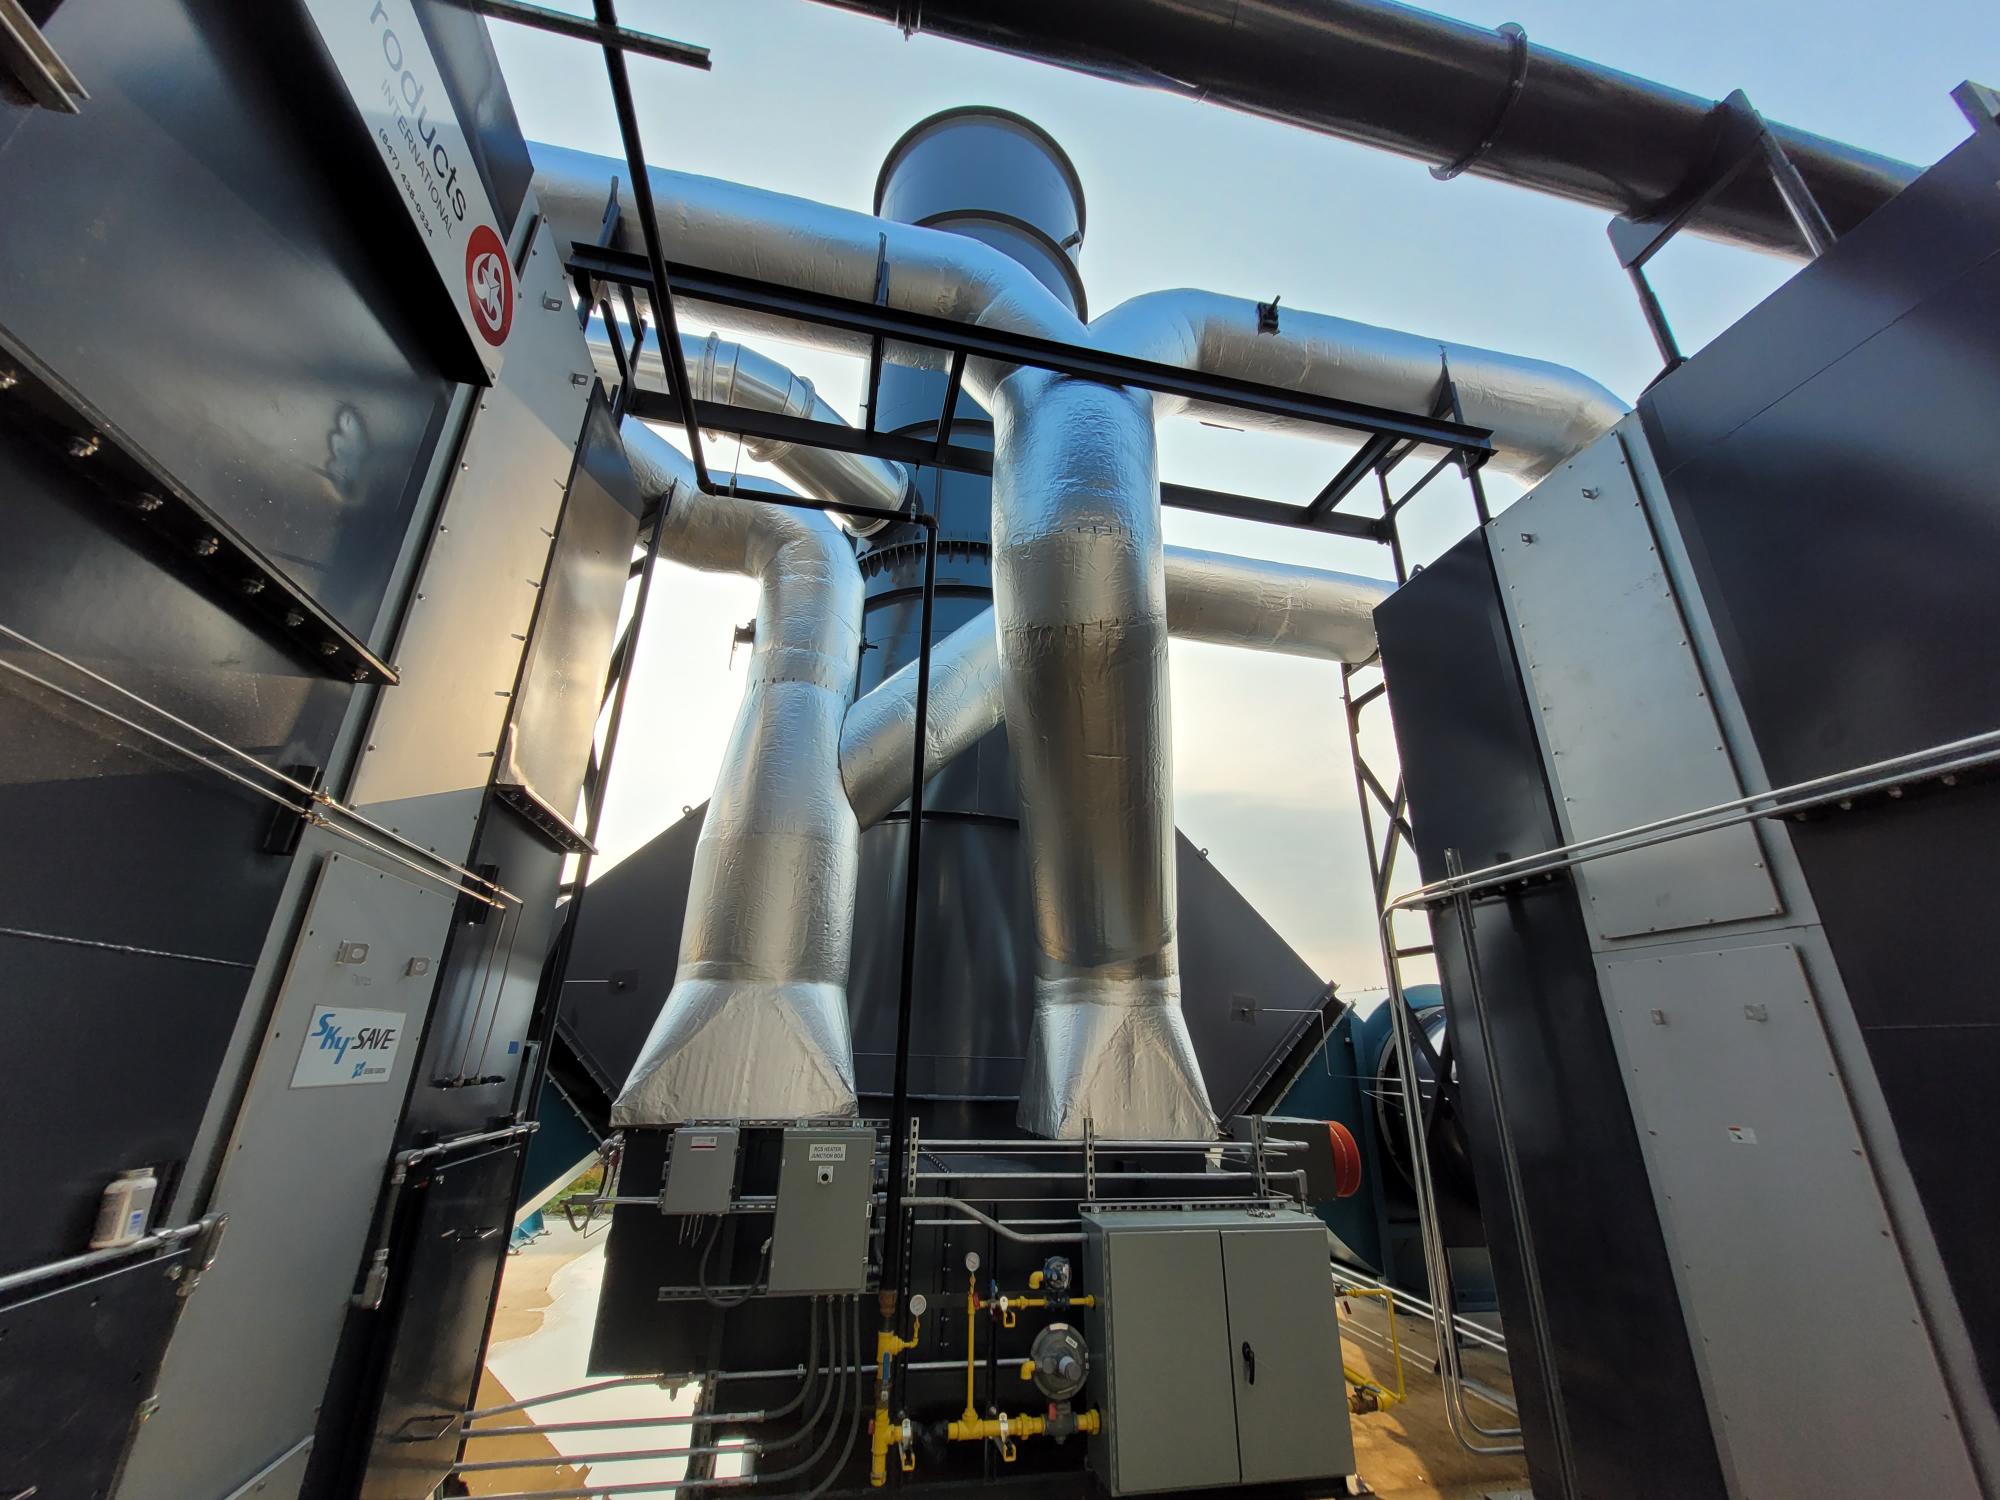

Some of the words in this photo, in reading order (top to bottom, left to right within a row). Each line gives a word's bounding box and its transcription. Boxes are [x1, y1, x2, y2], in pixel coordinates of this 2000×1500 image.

[379, 128, 400, 170] (847)
[381, 79, 454, 239] INTERNATIONAL
[351, 1027, 397, 1050] SAVE
